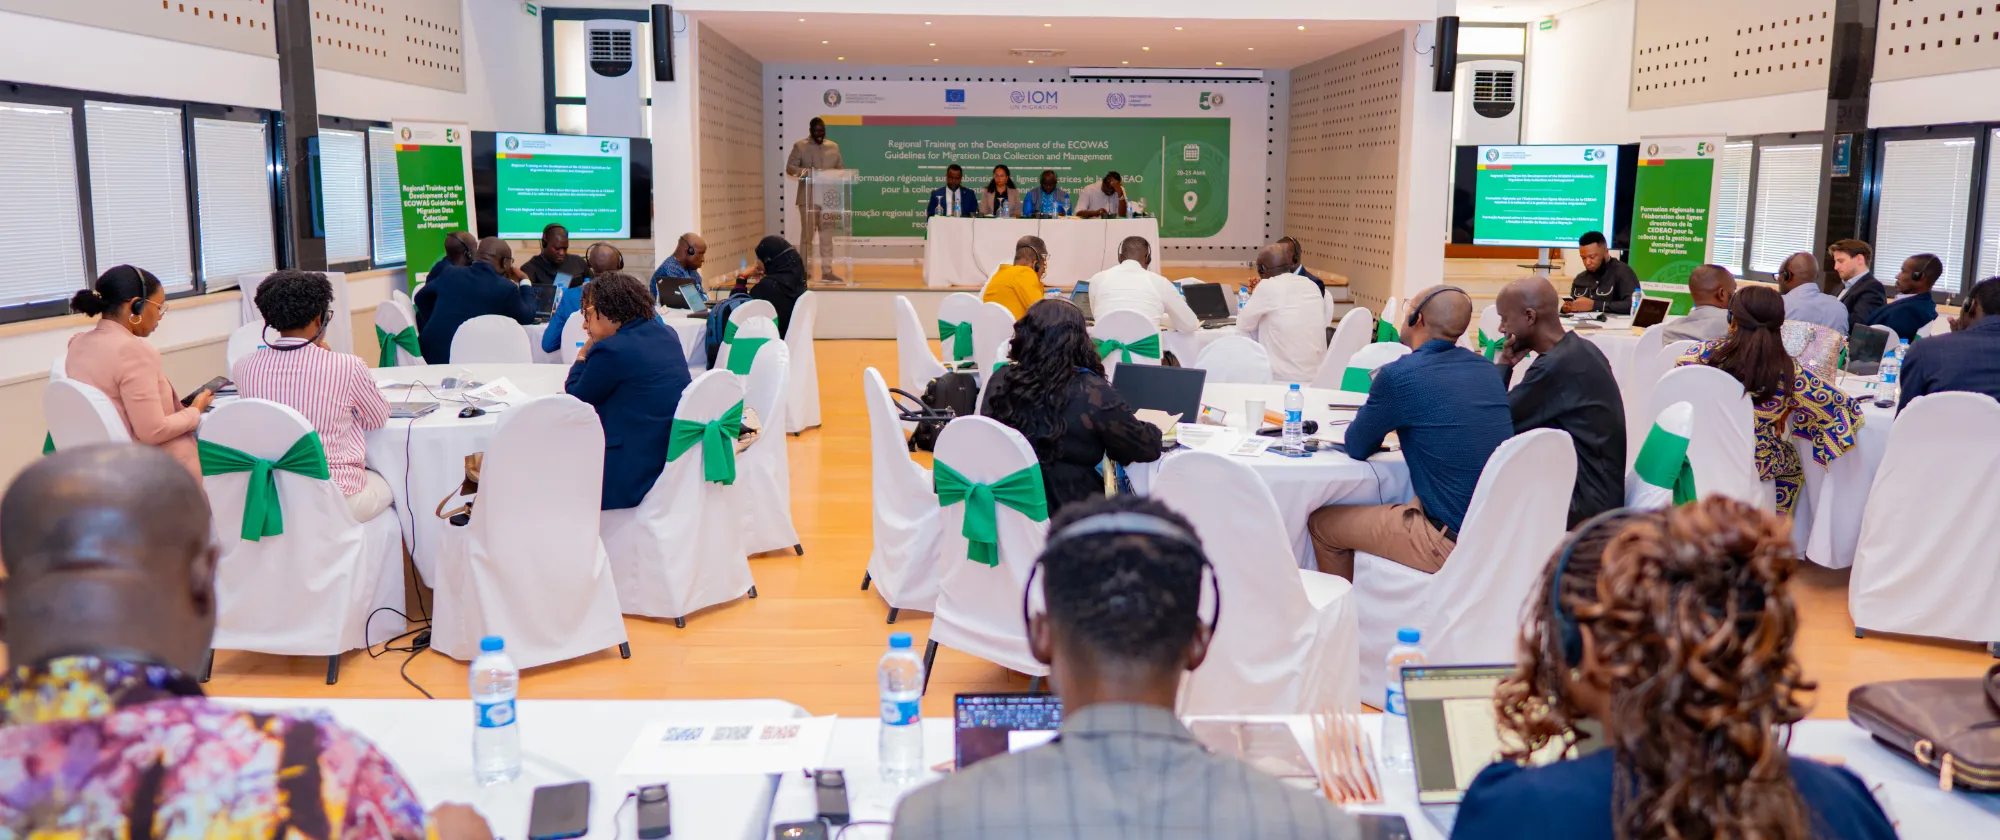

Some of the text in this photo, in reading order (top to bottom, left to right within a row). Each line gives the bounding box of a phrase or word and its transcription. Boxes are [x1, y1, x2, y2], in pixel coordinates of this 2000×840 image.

[1028, 91, 1058, 104] IOM
[888, 140, 922, 150] Regional
[924, 140, 956, 151] Training
[971, 141, 984, 149] the
[986, 141, 1040, 151] Development
[1042, 141, 1052, 149] of
[1052, 141, 1066, 149] the
[1068, 141, 1109, 150] ECOWAS
[884, 151, 1113, 163] Guidelines for Migration Data Collection and Management
[855, 174, 895, 183] Formation
[897, 173, 933, 185] régionale
[1016, 174, 1039, 185] lignes
[1084, 175, 1095, 183] de
[403, 185, 425, 193] Regional
[426, 185, 446, 193] Training
[882, 187, 900, 196] pour
[903, 185, 910, 193] la
[912, 185, 939, 194] collect
[409, 193, 443, 201] Development
[846, 209, 880, 218] ormação
[882, 209, 913, 219] regional
[1669, 207, 1695, 215] régionale
[1686, 214, 1703, 222] lignes
[1657, 247, 1688, 256] migrations
